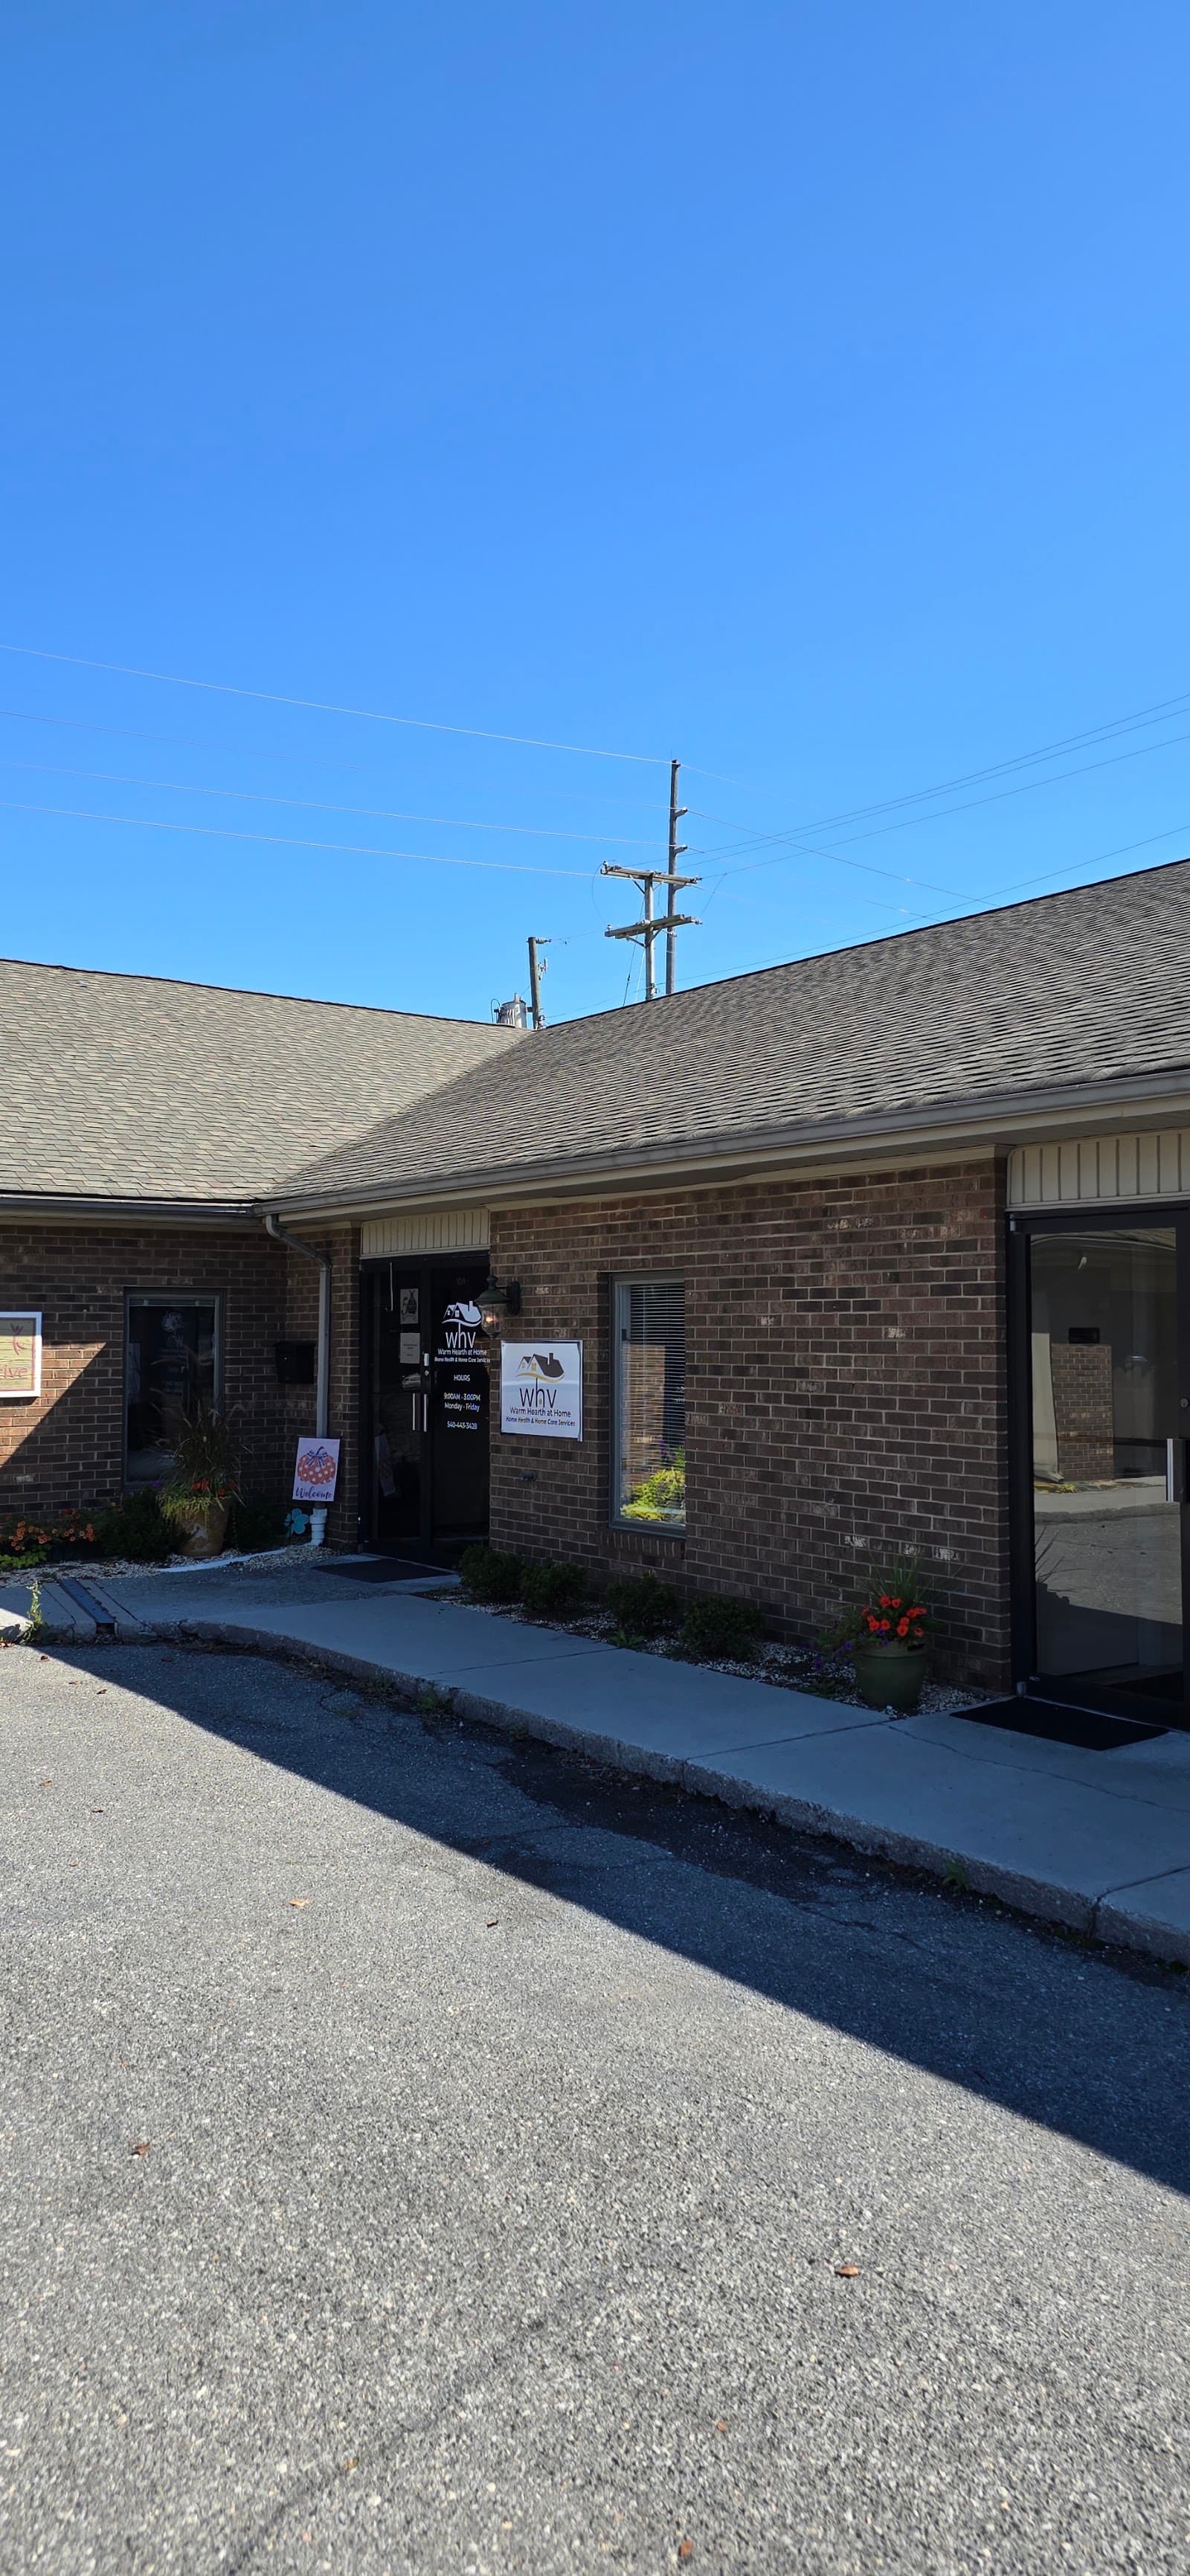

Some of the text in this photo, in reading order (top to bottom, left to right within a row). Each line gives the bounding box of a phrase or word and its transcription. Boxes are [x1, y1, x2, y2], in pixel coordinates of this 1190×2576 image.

[446, 1323, 476, 1348] whv
[519, 1377, 557, 1408] whv
[444, 1402, 463, 1411] Monday
[466, 1403, 480, 1412] Friday
[510, 1406, 526, 1414] Warm
[527, 1407, 545, 1416] Hearth
[554, 1409, 571, 1417] Home
[296, 1486, 332, 1500] Welcome
